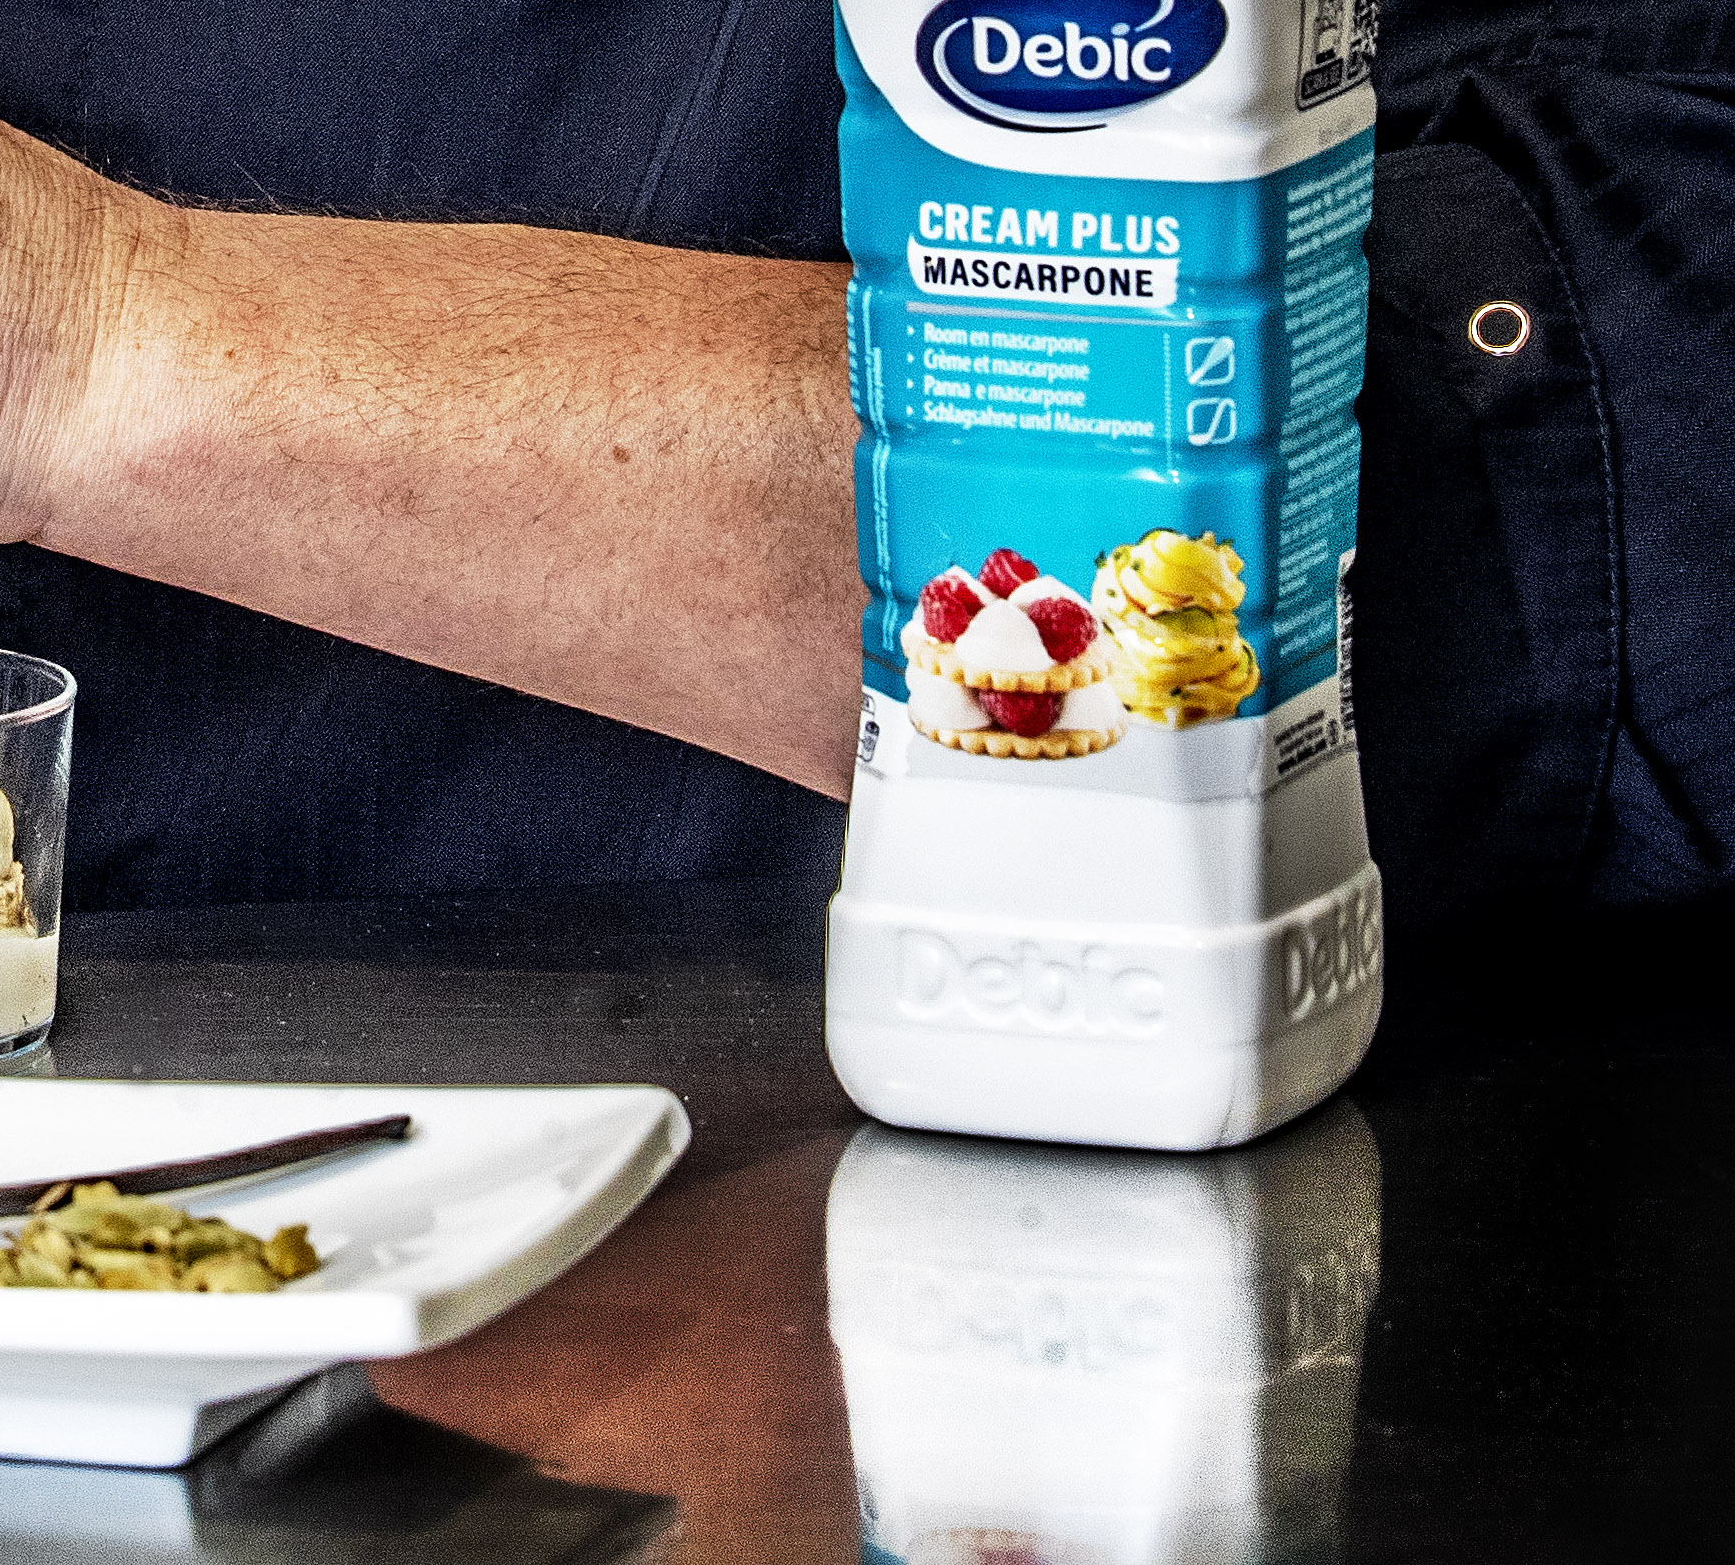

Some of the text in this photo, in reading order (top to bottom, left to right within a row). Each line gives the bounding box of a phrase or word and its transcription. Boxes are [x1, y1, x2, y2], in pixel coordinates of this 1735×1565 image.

[971, 16, 1172, 82] Debic
[918, 200, 1181, 255] CREAM PLUS
[923, 255, 1154, 297] MASCARPONE
[923, 322, 1090, 357] Room en mascarpone
[973, 355, 990, 374] et
[991, 358, 1090, 383] mascarpone
[923, 374, 1086, 410] Panna e mascarpone
[923, 400, 1155, 440] Schlagsahne und Mascarpone
